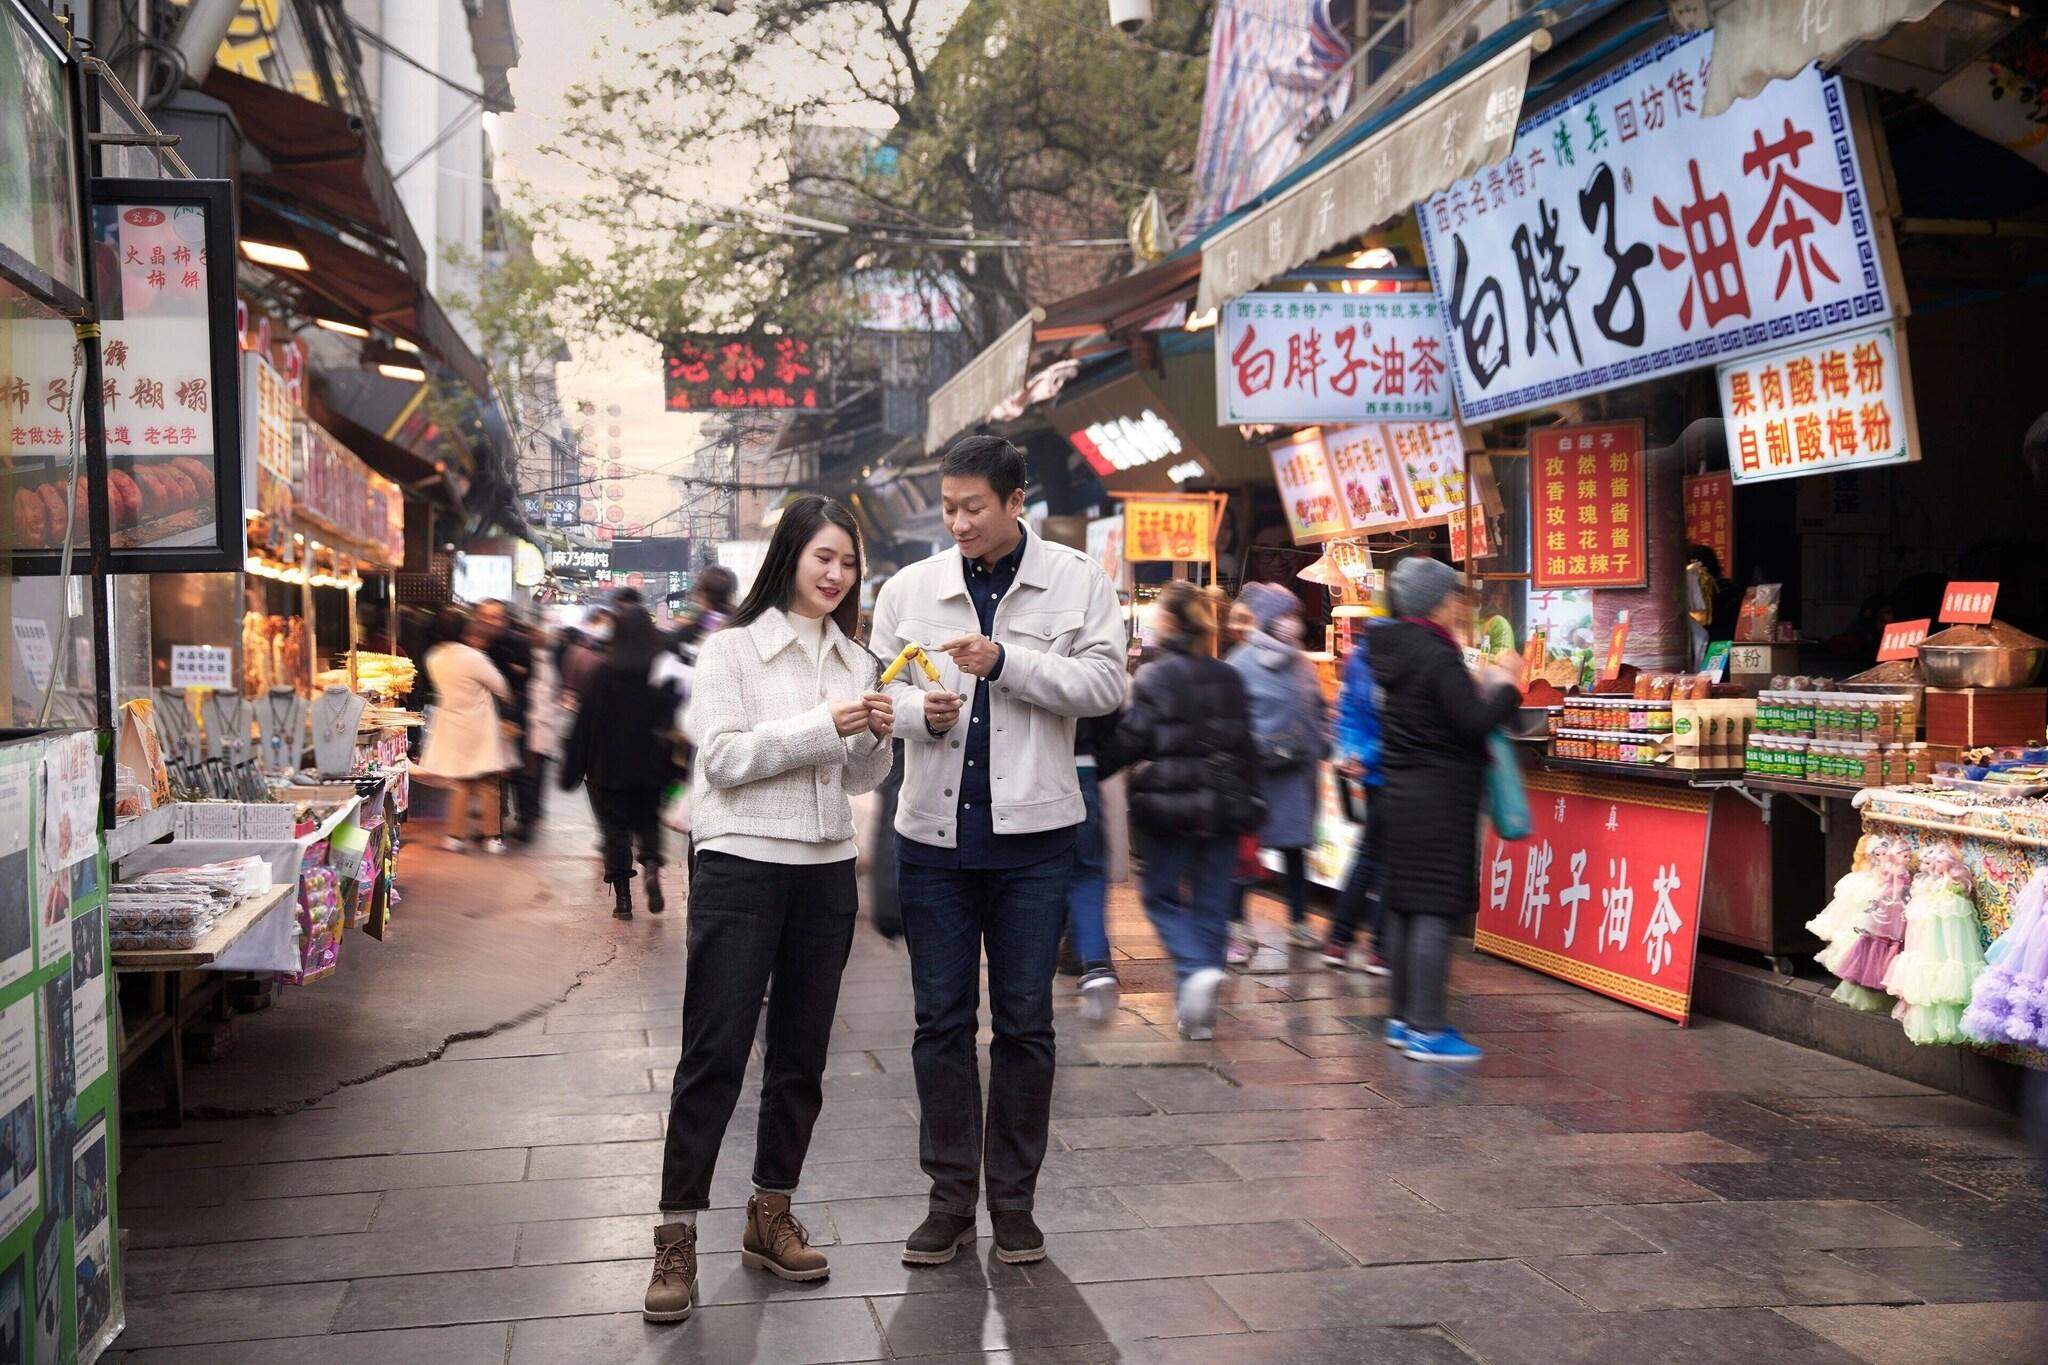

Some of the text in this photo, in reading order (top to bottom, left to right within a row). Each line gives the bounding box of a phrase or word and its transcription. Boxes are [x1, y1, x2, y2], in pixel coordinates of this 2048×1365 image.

[1432, 147, 1546, 233] 西安名贵特产
[1552, 101, 1608, 167] 清真
[1448, 117, 1844, 390] 白胖子油茶
[147, 270, 200, 290] 柿饼
[1237, 303, 1333, 318] 西安名贵特产
[1231, 323, 1445, 398] 白胖子油茶
[1730, 341, 1884, 416] 果肉酸梅粉
[1366, 402, 1433, 414] 西羊市19号
[11, 426, 65, 446] 老做法
[144, 426, 197, 446] 老名字
[1559, 433, 1614, 450] 白胖子
[1738, 400, 1892, 472] 自制酸梅粉
[1545, 452, 1629, 476] 孜然粉
[1546, 477, 1630, 502] 香辣酱
[1693, 482, 1719, 498] 白胖子
[1453, 507, 1479, 523] 店长荐
[1546, 502, 1630, 526] 玫瑰酱
[1546, 527, 1631, 551] 桂花酱
[1547, 553, 1631, 576] 油泼辣子
[1553, 797, 1619, 832] 清真
[1490, 839, 1683, 976] 白胖子油茶
